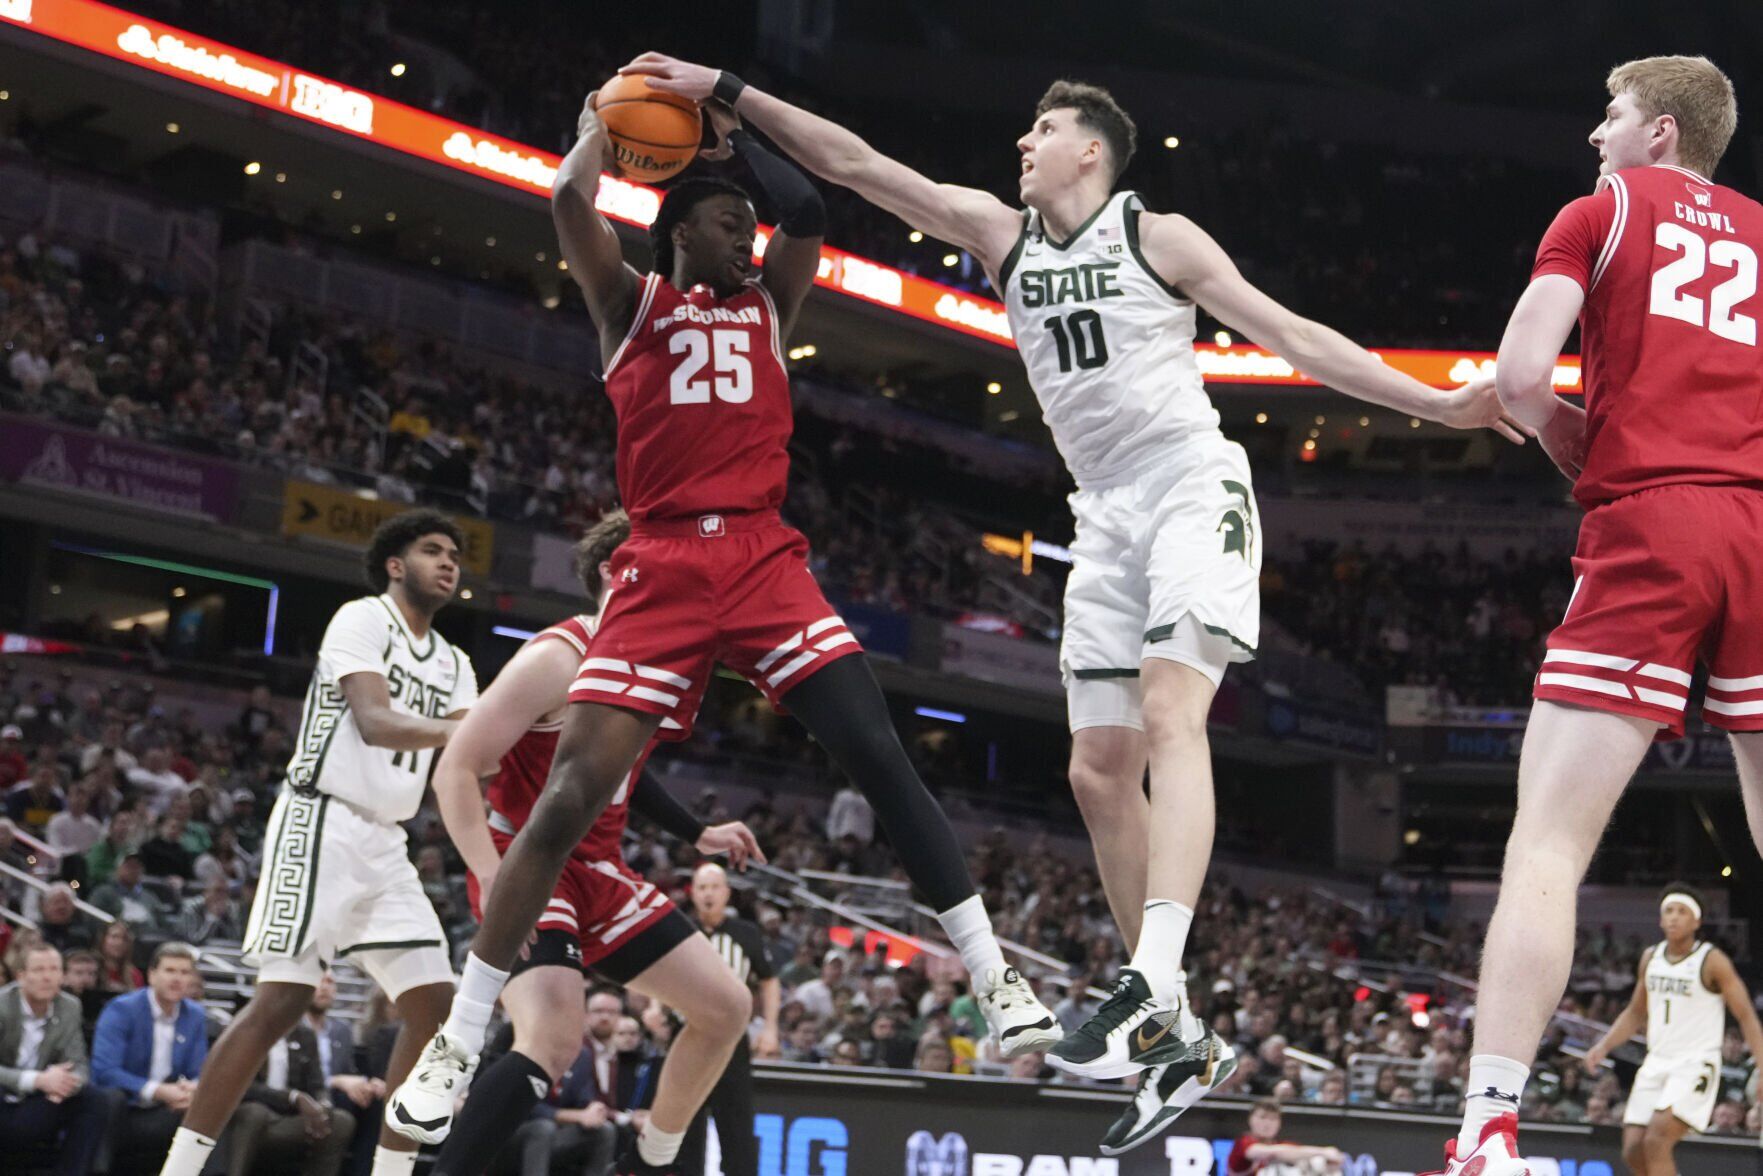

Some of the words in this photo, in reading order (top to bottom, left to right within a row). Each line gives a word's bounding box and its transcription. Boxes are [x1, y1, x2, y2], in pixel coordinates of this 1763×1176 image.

[613, 142, 684, 172] Wilson
[1674, 201, 1736, 234] CROWL
[1020, 262, 1125, 308] STATE
[1649, 221, 1758, 347] 22
[1044, 309, 1109, 373] 10
[669, 329, 753, 405] 25
[388, 664, 452, 719] STATE
[1648, 975, 1694, 997] STATE
[1664, 999, 1671, 1024] 1
